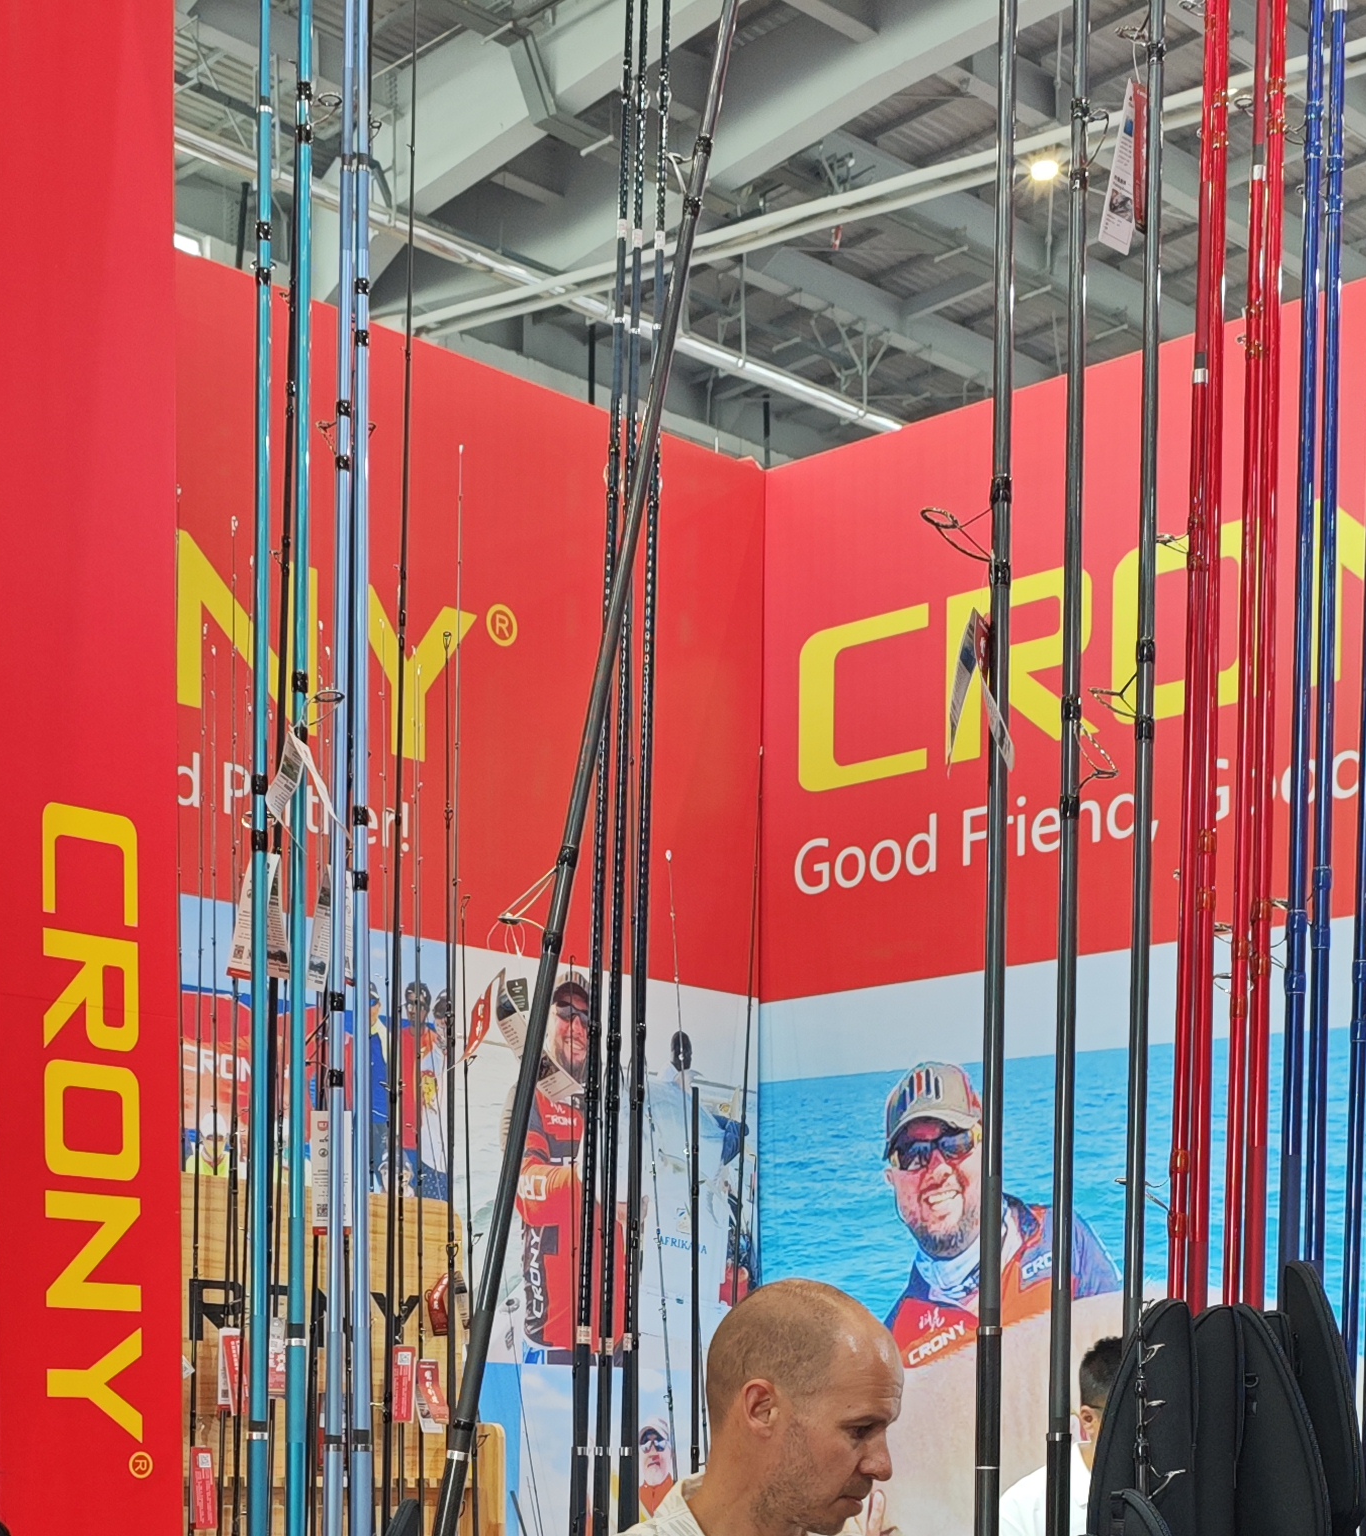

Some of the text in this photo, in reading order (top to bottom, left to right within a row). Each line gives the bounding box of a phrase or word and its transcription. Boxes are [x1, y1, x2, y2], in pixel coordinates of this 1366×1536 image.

[793, 815, 938, 896] Good
[41, 801, 144, 1444] CRONY
[530, 1229, 544, 1319] CRONY
[908, 1319, 966, 1367] CRONY
